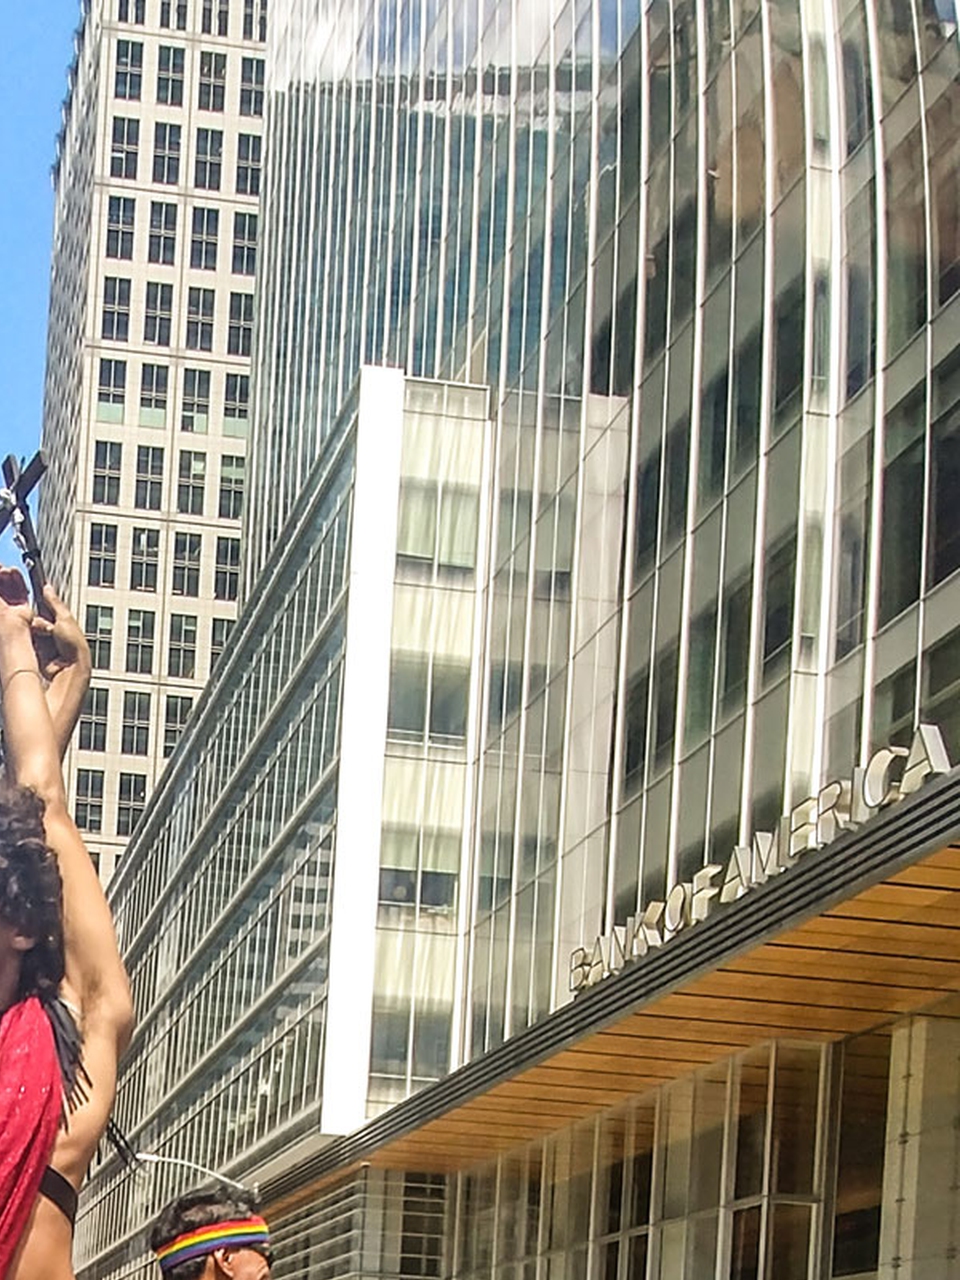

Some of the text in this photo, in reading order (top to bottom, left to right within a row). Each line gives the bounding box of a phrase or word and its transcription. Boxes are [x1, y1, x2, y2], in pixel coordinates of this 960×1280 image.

[570, 723, 952, 991] BANK OF AMERICA
